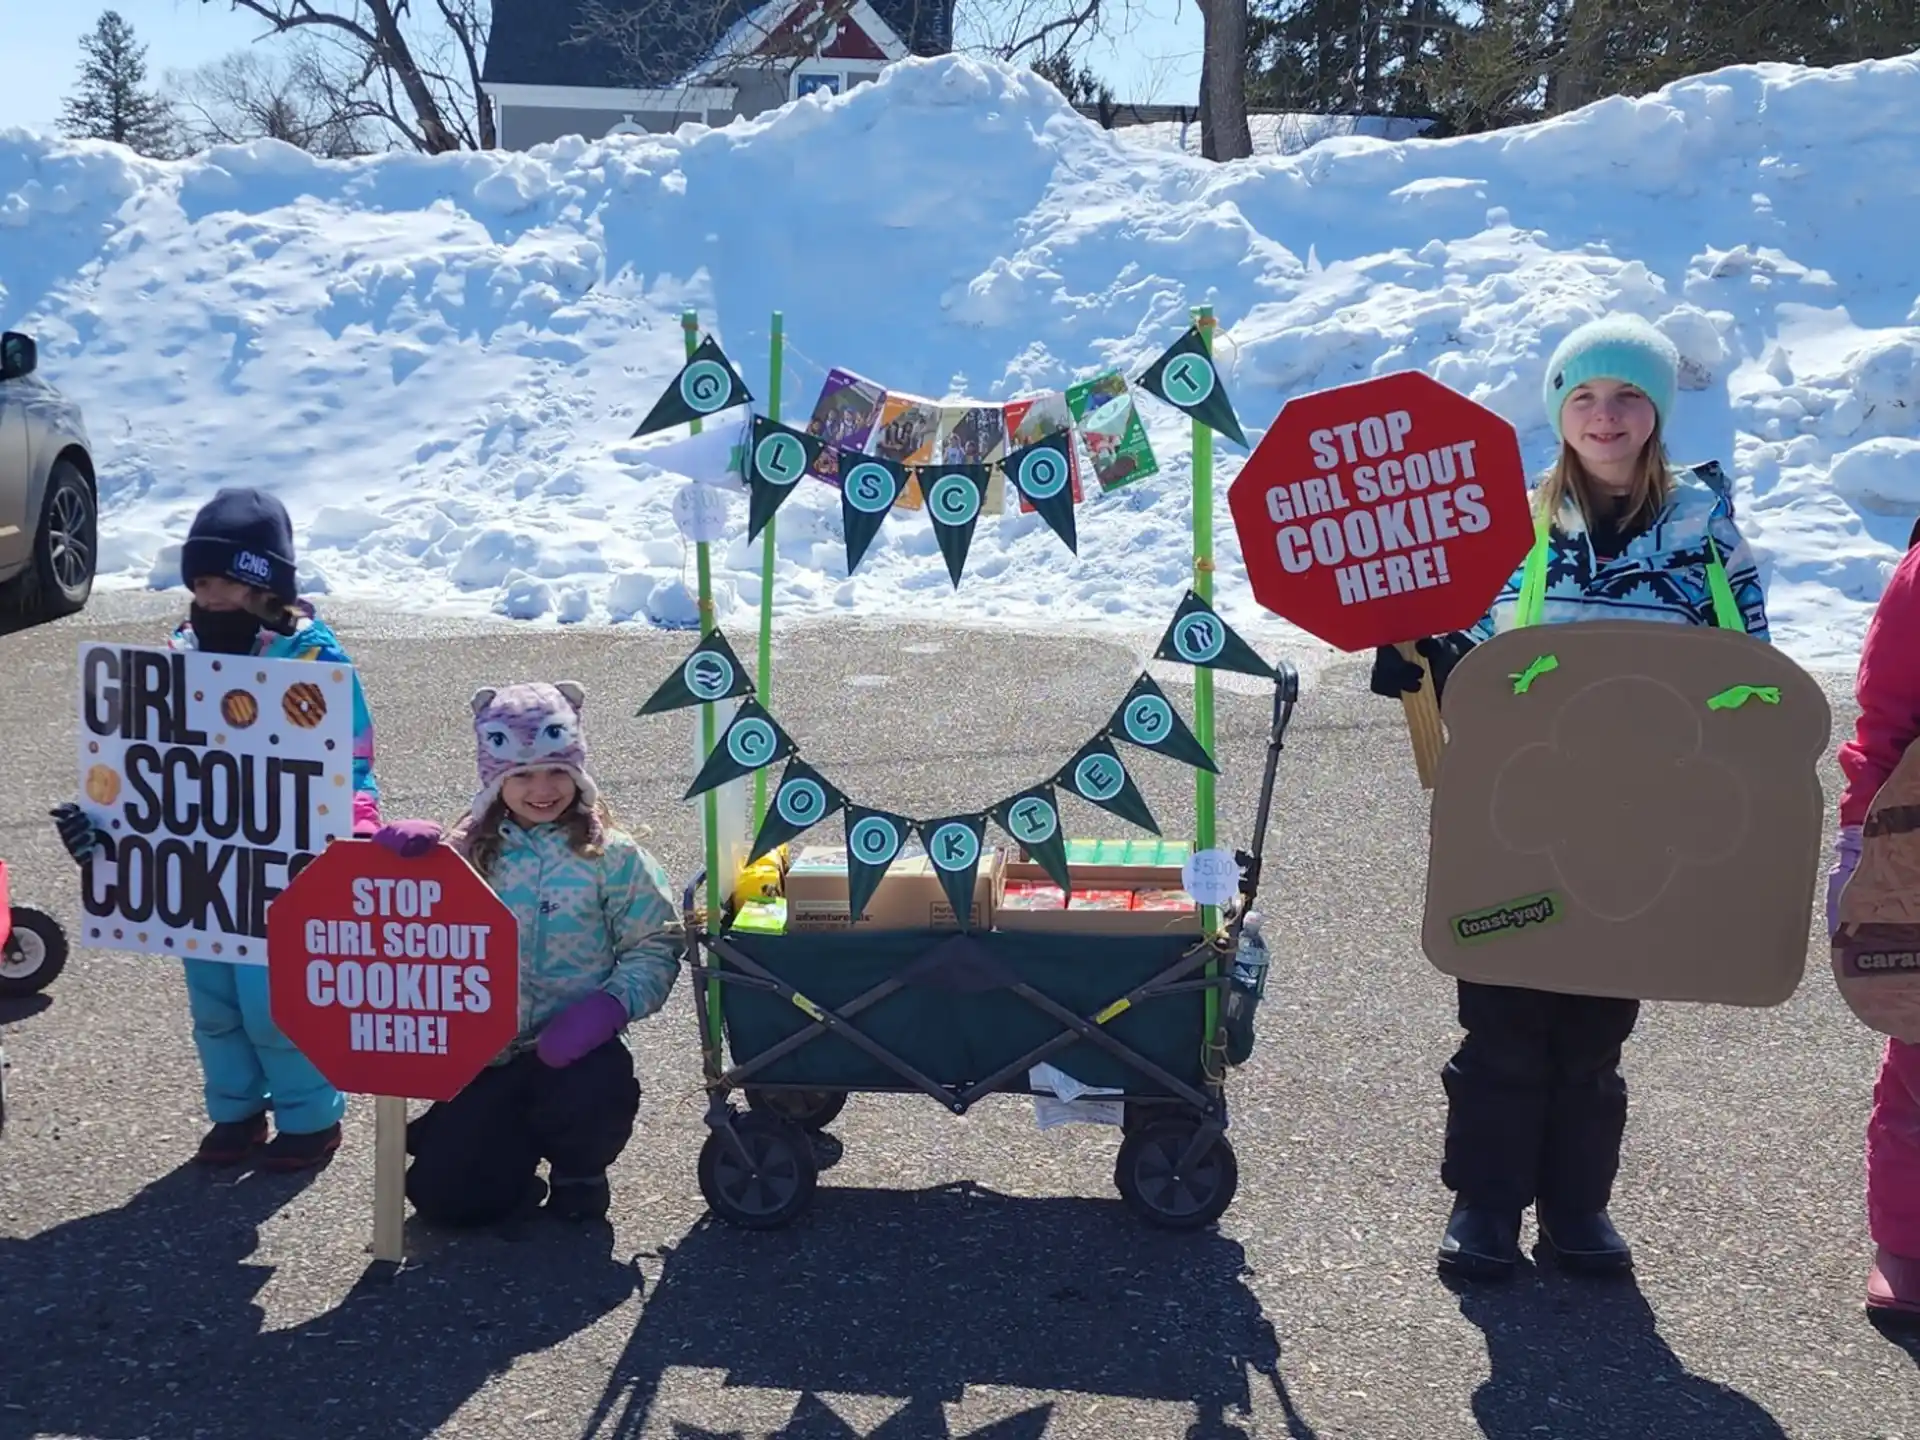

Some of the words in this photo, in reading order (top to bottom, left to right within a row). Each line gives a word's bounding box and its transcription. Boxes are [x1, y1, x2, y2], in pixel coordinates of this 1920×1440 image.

[692, 374, 720, 400] G
[770, 442, 788, 473] L
[857, 474, 882, 500] S
[941, 487, 965, 513] C
[1031, 459, 1055, 486] O
[1172, 364, 1199, 392] T
[1309, 410, 1412, 470] STOP
[1265, 474, 1350, 523] GIRL
[1353, 440, 1476, 503] SCOUT
[1276, 484, 1491, 574] COOKIES
[1334, 546, 1451, 606] HERE!
[84, 647, 207, 746] GIRL
[123, 743, 324, 850] SCOUT
[740, 730, 766, 755] C
[789, 789, 814, 814] O
[863, 828, 886, 853] O
[944, 833, 966, 860] K
[1018, 805, 1046, 834] I
[1084, 763, 1114, 792] E
[1135, 706, 1162, 732] S
[82, 829, 317, 940] COOKIE
[352, 877, 441, 917] STOP
[1460, 900, 1551, 936] toast-yay!
[305, 919, 376, 956] GIRL
[383, 922, 490, 960] SCOUT
[306, 960, 491, 1013] COOKIES
[350, 1013, 448, 1054] HERE!
